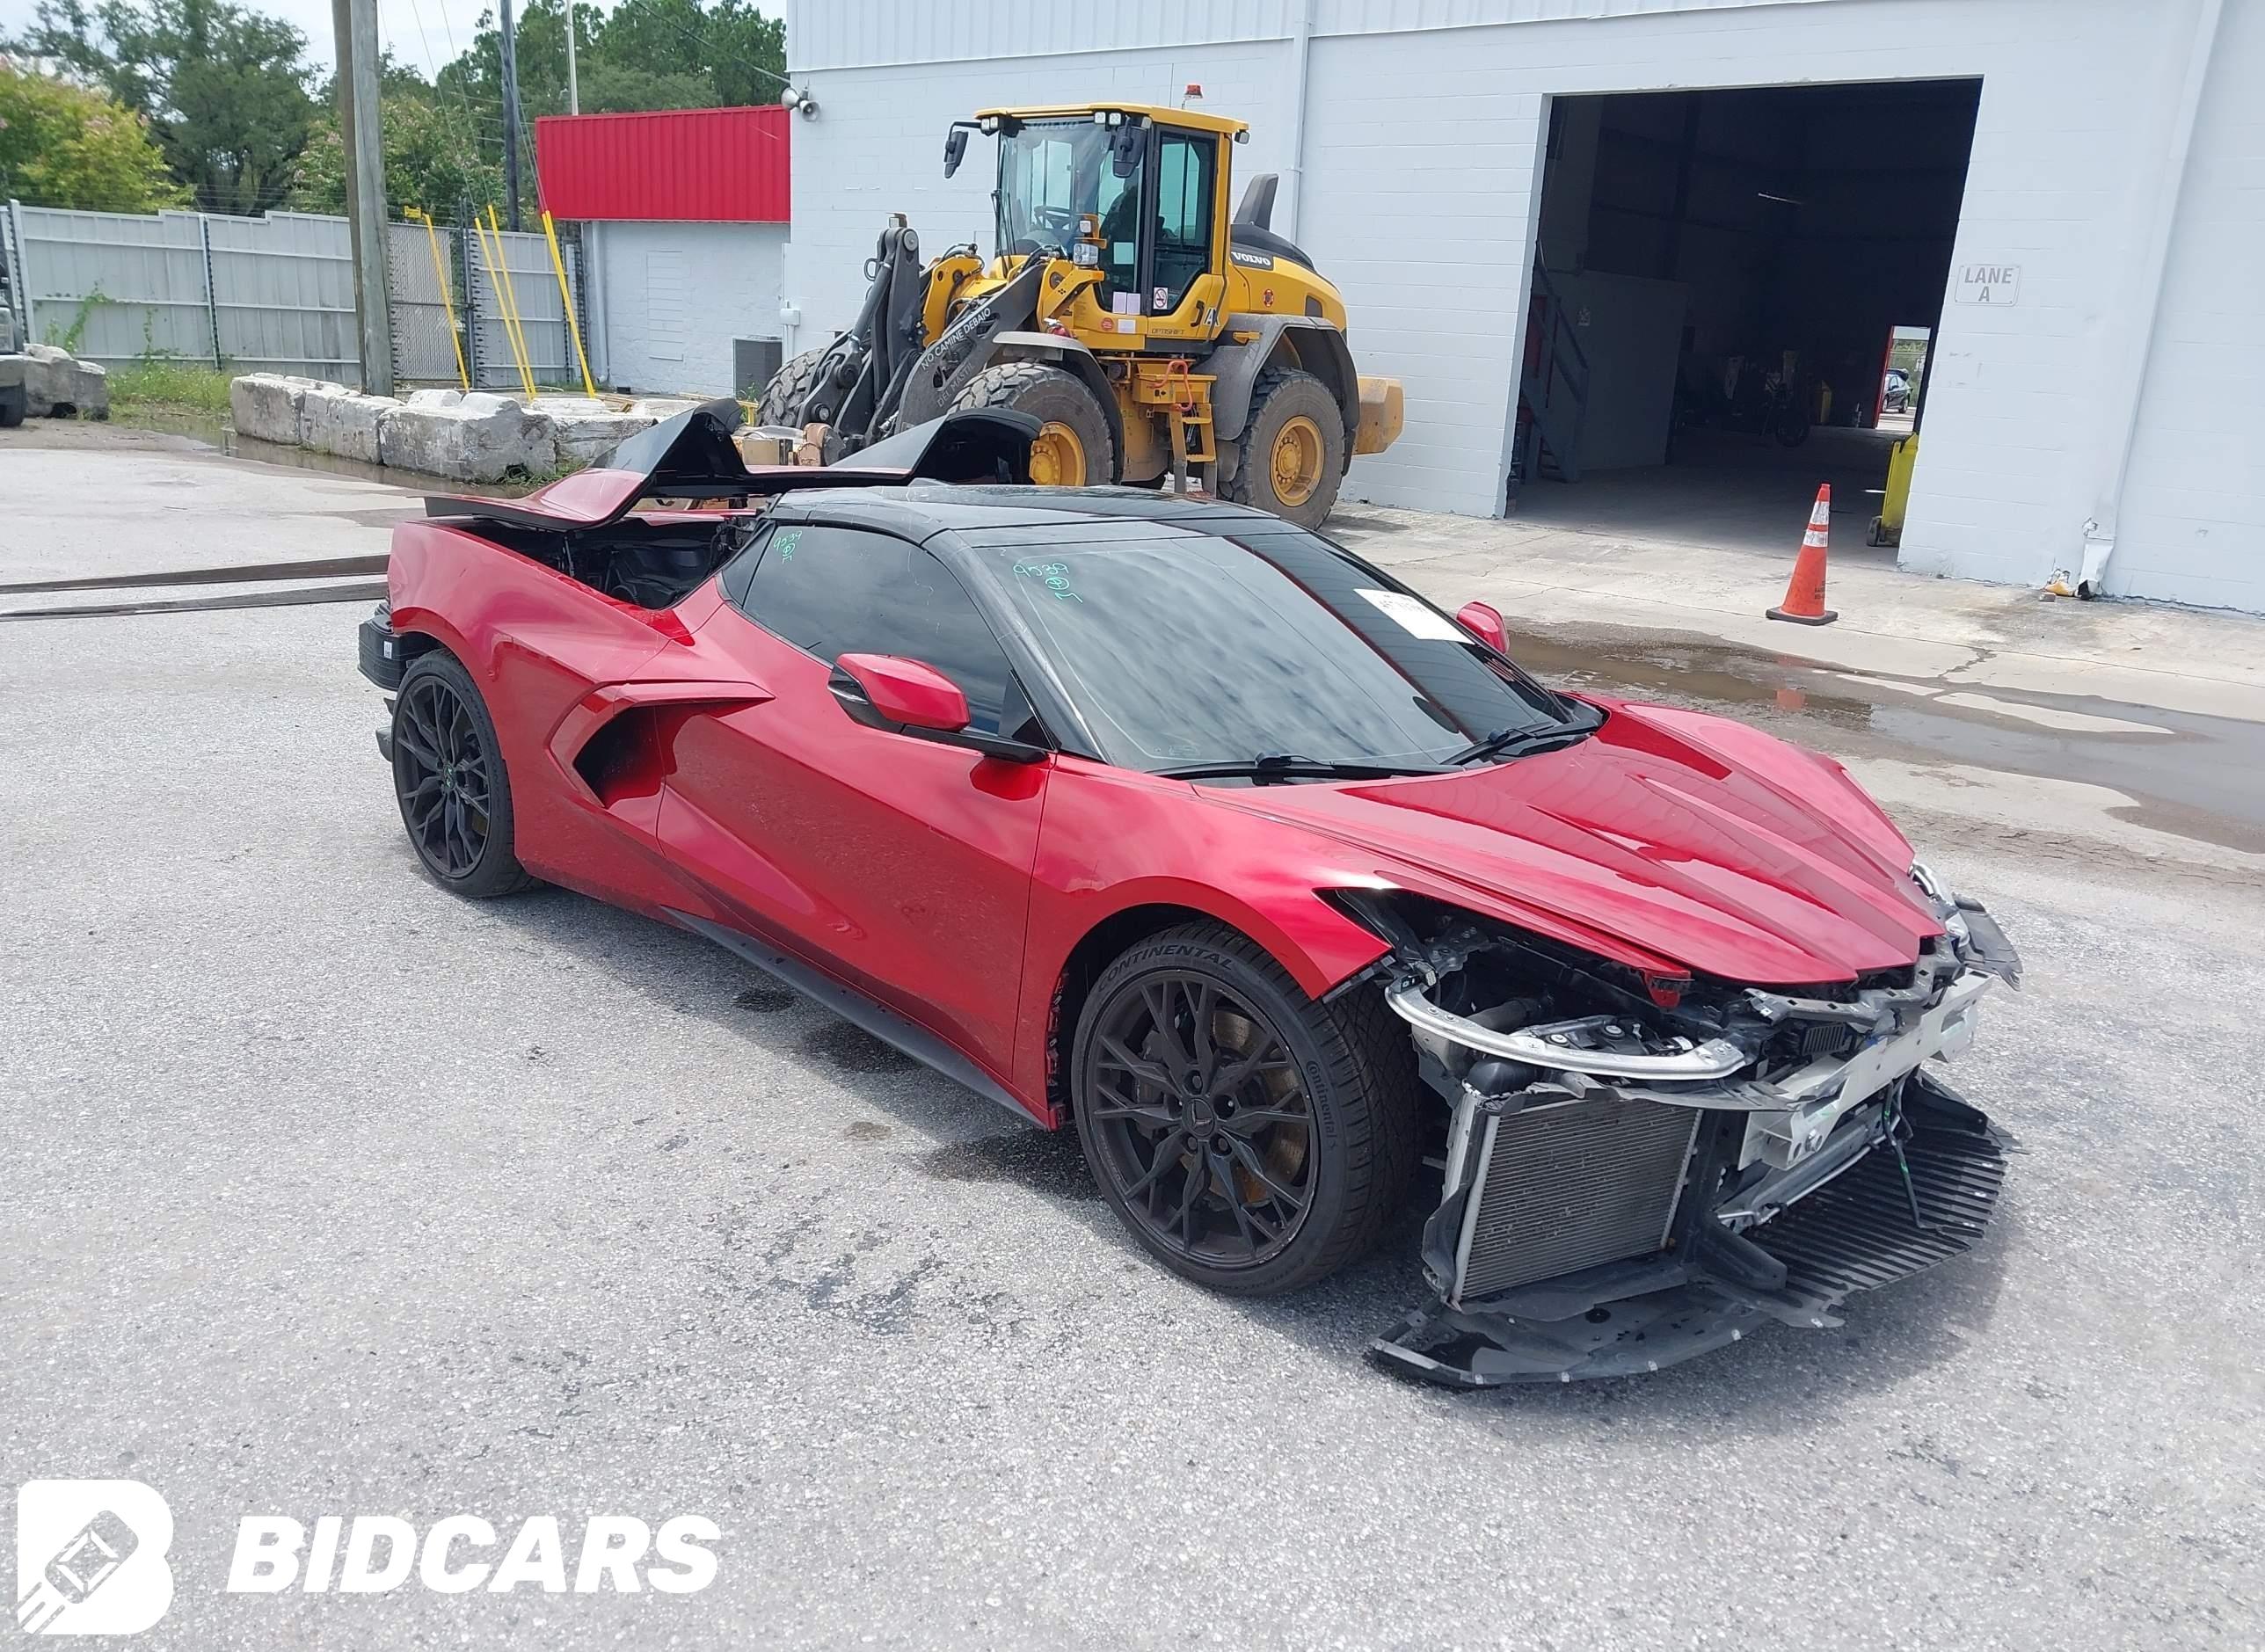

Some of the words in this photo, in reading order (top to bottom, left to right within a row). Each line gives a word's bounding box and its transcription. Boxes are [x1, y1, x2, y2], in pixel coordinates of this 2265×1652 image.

[1231, 251, 1271, 266] VOLVO
[1964, 266, 2014, 284] LANE
[1977, 285, 1991, 302] A
[921, 353, 934, 370] NO
[935, 331, 965, 356] CAMINE
[936, 389, 951, 407] DEL
[1099, 943, 1232, 993] CONTINENTAL
[1306, 1060, 1337, 1138] Continental
